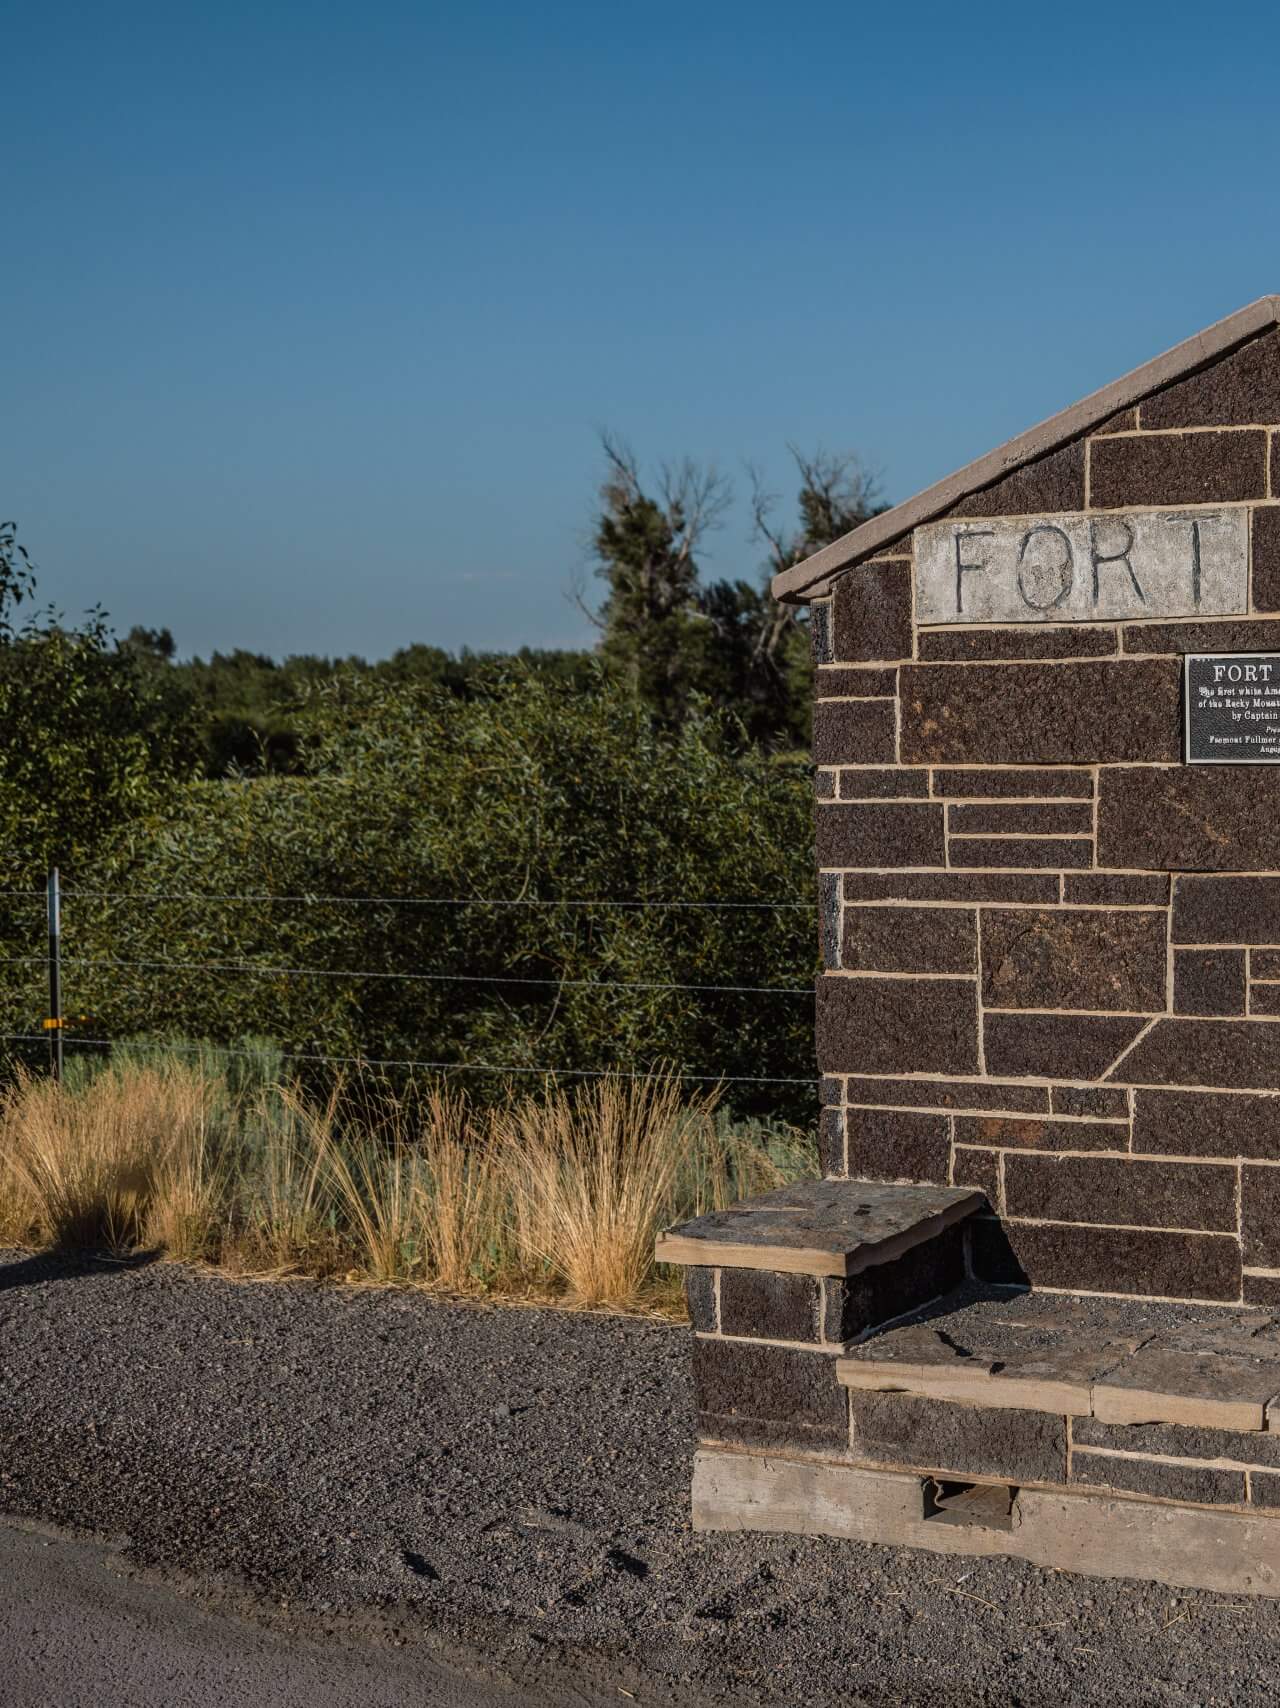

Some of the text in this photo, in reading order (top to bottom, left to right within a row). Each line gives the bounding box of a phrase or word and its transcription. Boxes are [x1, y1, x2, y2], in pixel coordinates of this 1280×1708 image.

[954, 514, 1221, 613] FORT
[1213, 665, 1273, 682] FORT
[1199, 687, 1214, 698] The
[1218, 687, 1235, 696] first
[1239, 686, 1262, 696] white
[1198, 700, 1207, 708] of
[1209, 699, 1222, 708] the
[1226, 699, 1250, 709] Rocky
[1232, 711, 1242, 721] by
[1245, 711, 1278, 721] Captain
[1245, 736, 1277, 744] Fullmer
